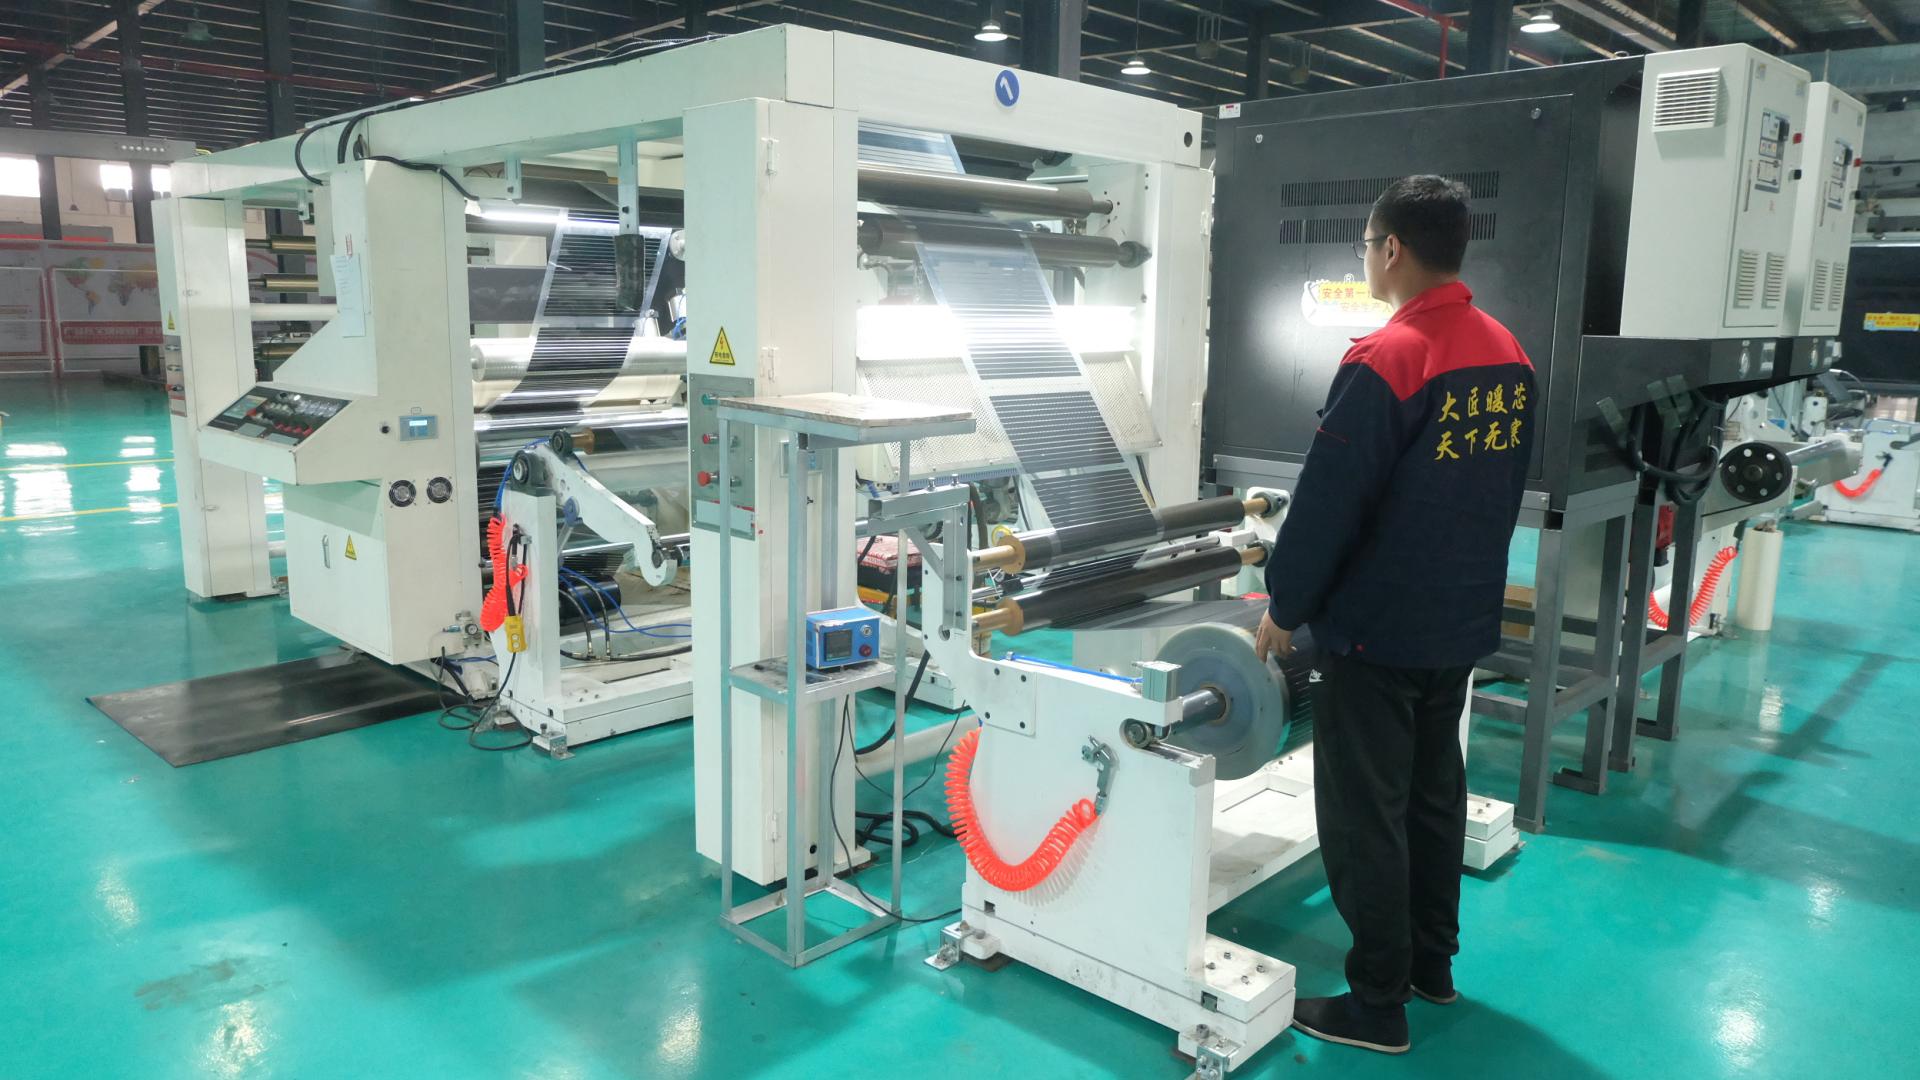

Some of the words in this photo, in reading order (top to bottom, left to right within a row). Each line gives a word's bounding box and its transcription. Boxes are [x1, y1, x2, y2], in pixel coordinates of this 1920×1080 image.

[1322, 287, 1372, 299] 安全第一
[1438, 382, 1527, 422] 大匠暖芯
[1434, 418, 1523, 460] 天下无寒
